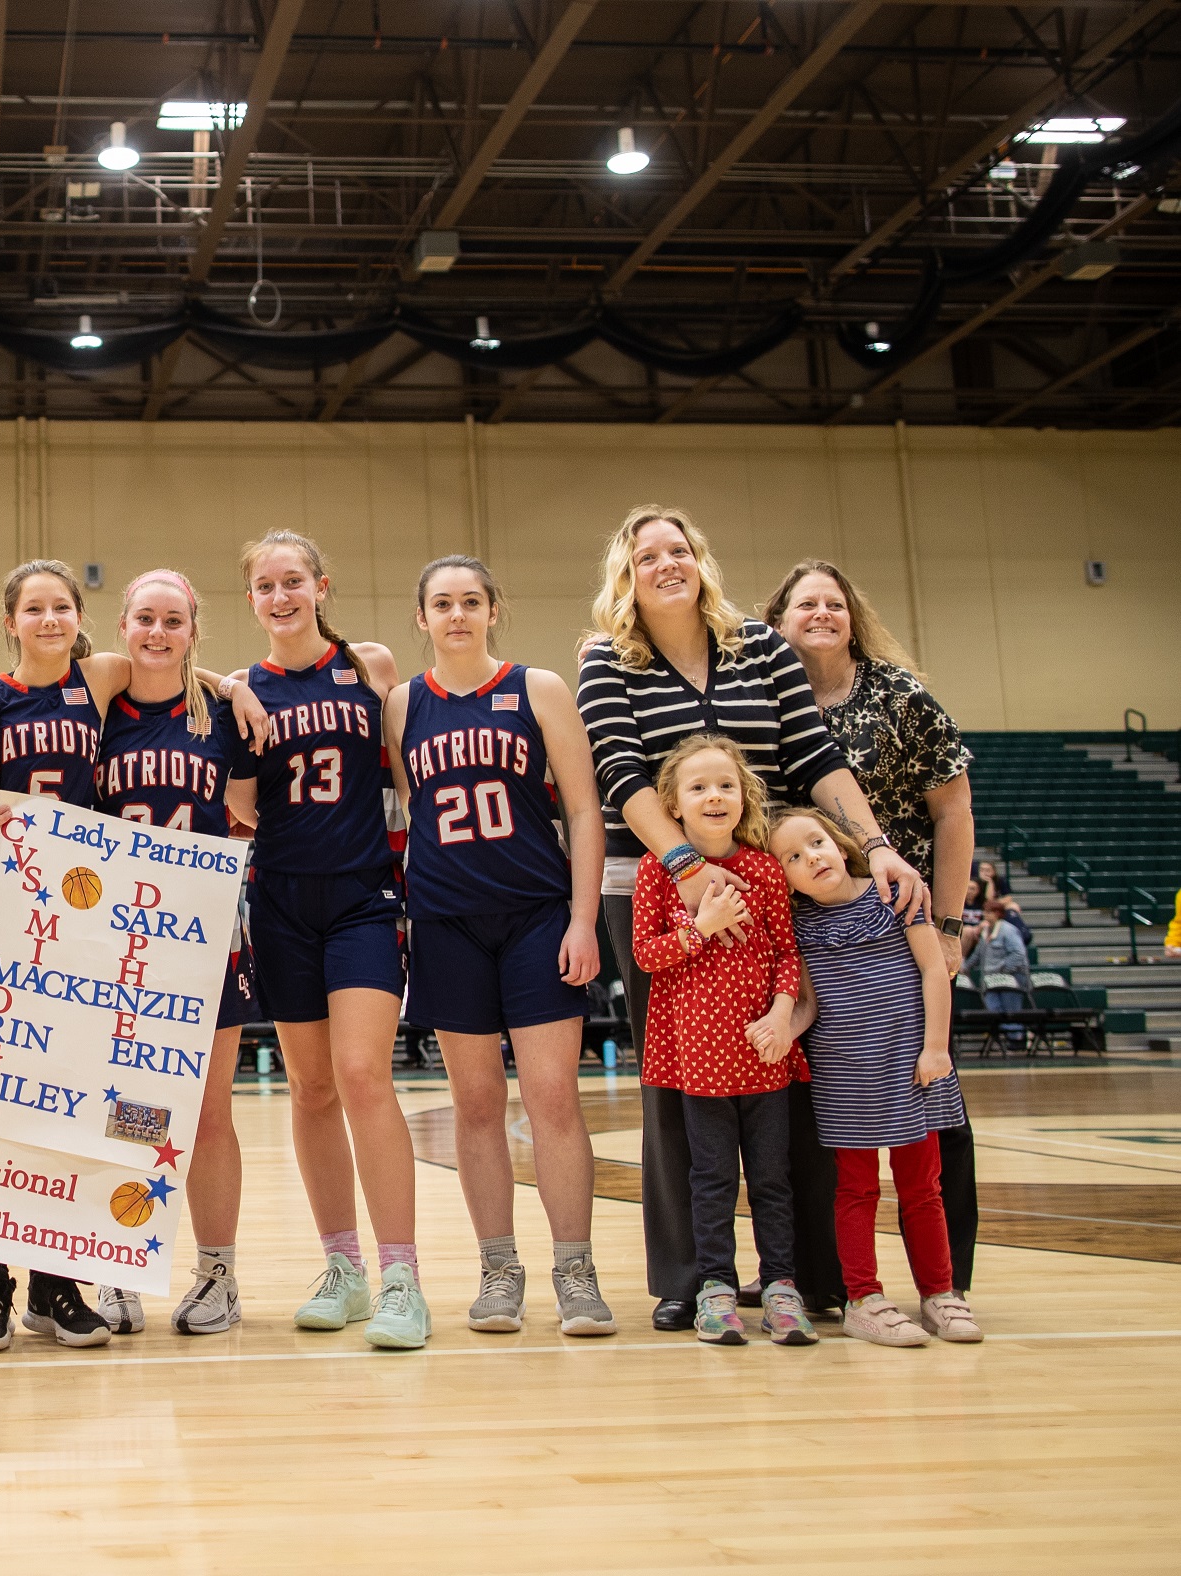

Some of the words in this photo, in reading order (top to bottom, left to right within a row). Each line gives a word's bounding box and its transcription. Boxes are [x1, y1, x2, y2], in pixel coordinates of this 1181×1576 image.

[268, 699, 369, 751] ATRIOTS
[289, 746, 343, 805] 13
[409, 727, 530, 789] PATRIOTS
[433, 779, 515, 846] 20
[48, 810, 120, 862] Lady
[128, 831, 238, 875] Patriots
[110, 903, 208, 944] SARA
[108, 1037, 206, 1079] ERIN
